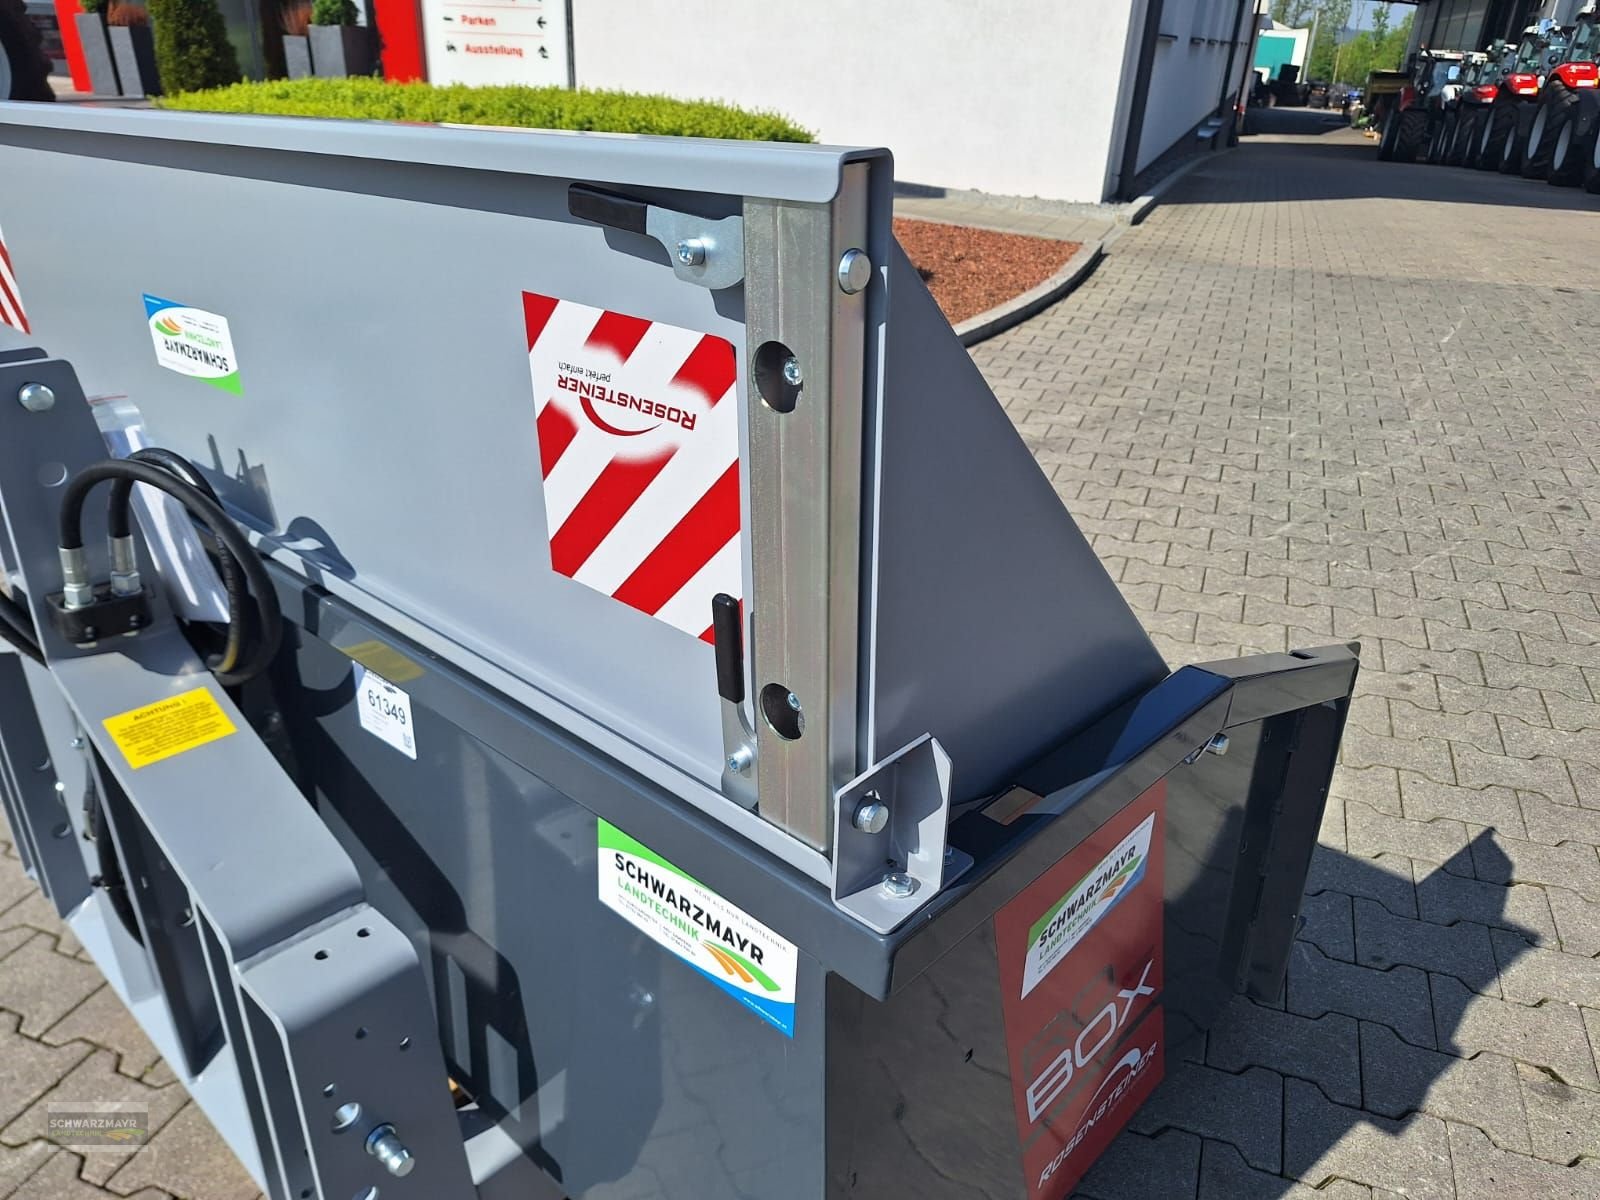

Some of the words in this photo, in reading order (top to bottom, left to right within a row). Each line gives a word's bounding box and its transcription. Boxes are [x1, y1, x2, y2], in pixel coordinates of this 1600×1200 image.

[461, 14, 497, 26] Parken
[465, 43, 524, 58] Ausstellung
[558, 361, 584, 375] einfach
[585, 368, 611, 383] perfekt
[557, 374, 697, 431] ROSENSTEINER
[368, 689, 406, 725] 61349
[615, 852, 764, 965] SCHWARZMAYR
[617, 876, 700, 941] LANDTECHNIK
[1039, 844, 1136, 948] SCHWARZMAYR
[1038, 899, 1099, 961] LANDTECHNIK
[1026, 958, 1155, 1124] BOX
[1038, 1041, 1158, 1189] ROSENSTEINER
